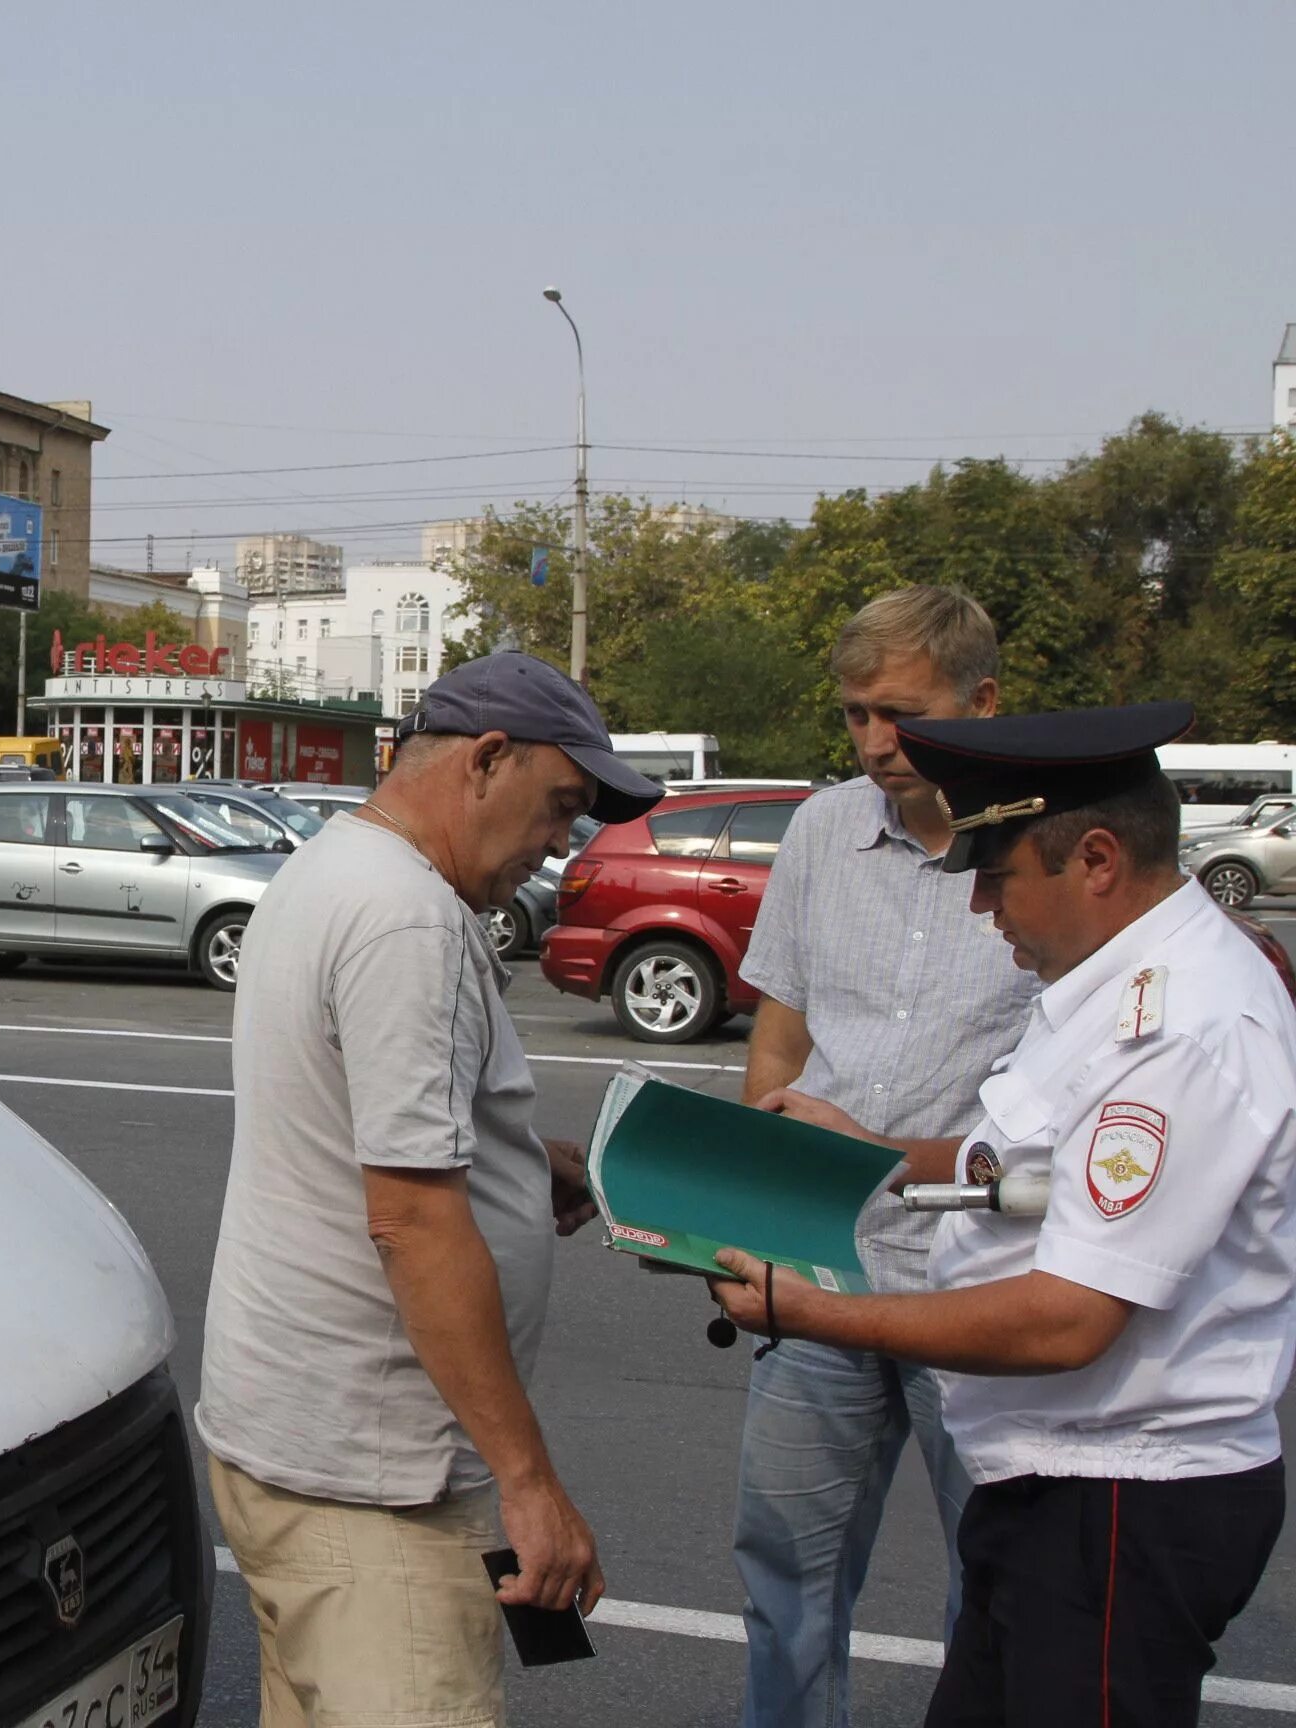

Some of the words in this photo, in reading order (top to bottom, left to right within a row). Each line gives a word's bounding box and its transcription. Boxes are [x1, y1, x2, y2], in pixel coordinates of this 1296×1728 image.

[75, 629, 230, 676] rieker
[64, 680, 223, 697] ANTISTRESS
[1098, 1196, 1124, 1213] МВД
[132, 1692, 156, 1723] RUS
